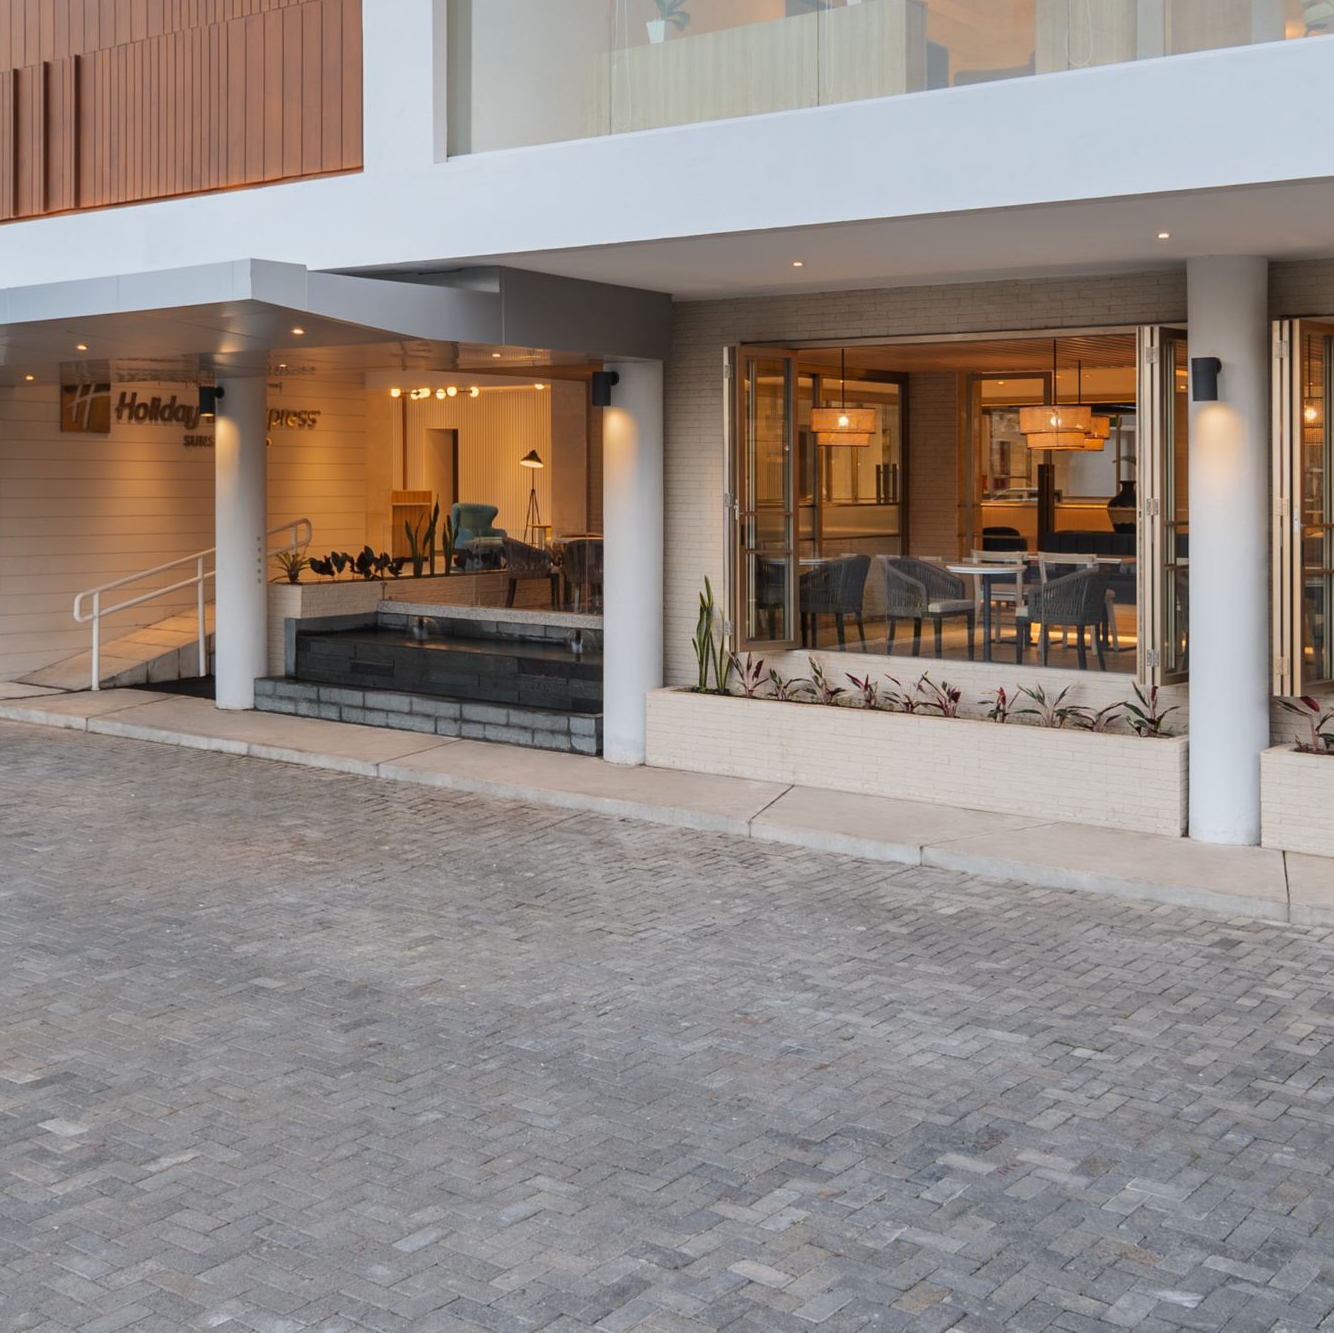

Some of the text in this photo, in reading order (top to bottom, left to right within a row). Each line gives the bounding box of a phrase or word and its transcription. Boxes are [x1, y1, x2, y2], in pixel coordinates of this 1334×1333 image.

[115, 391, 200, 431] Holiday
[266, 407, 321, 432] press
[183, 435, 215, 448] SUNS
